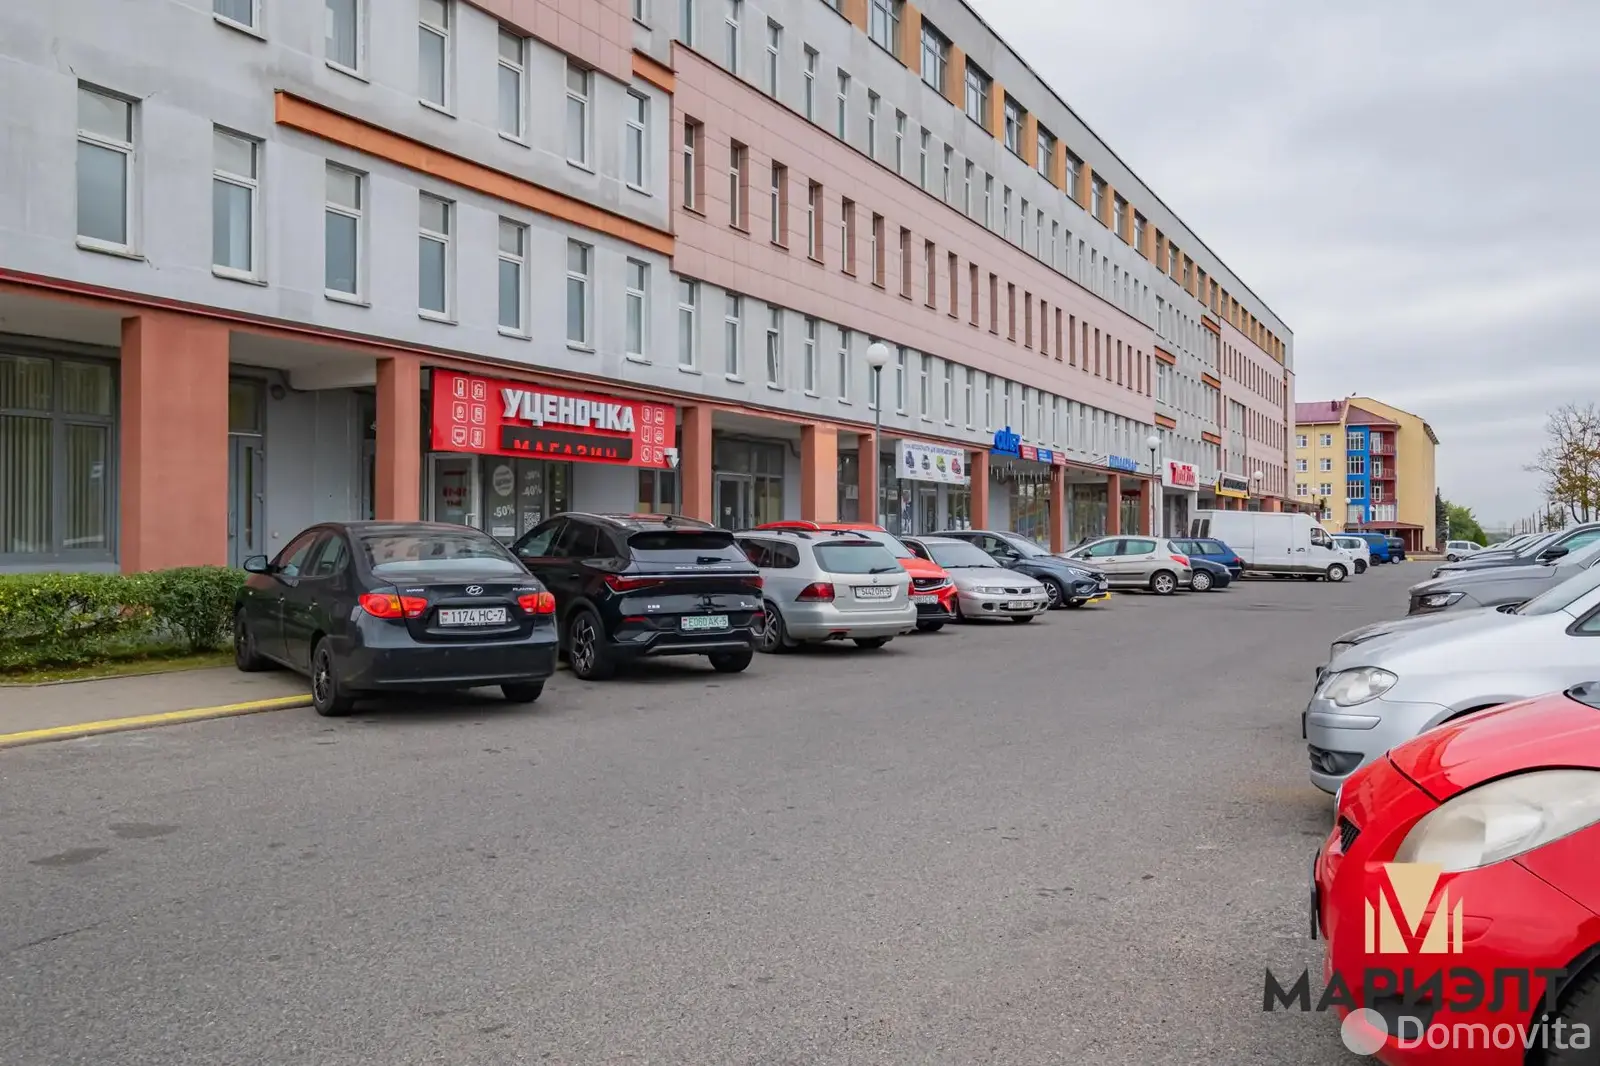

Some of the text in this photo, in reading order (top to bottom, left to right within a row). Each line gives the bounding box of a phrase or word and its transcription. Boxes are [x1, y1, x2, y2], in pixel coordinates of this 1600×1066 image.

[500, 388, 636, 432] УЦЕНОЧКА
[493, 504, 515, 517] -50%
[451, 609, 504, 622] 1174 HC-7
